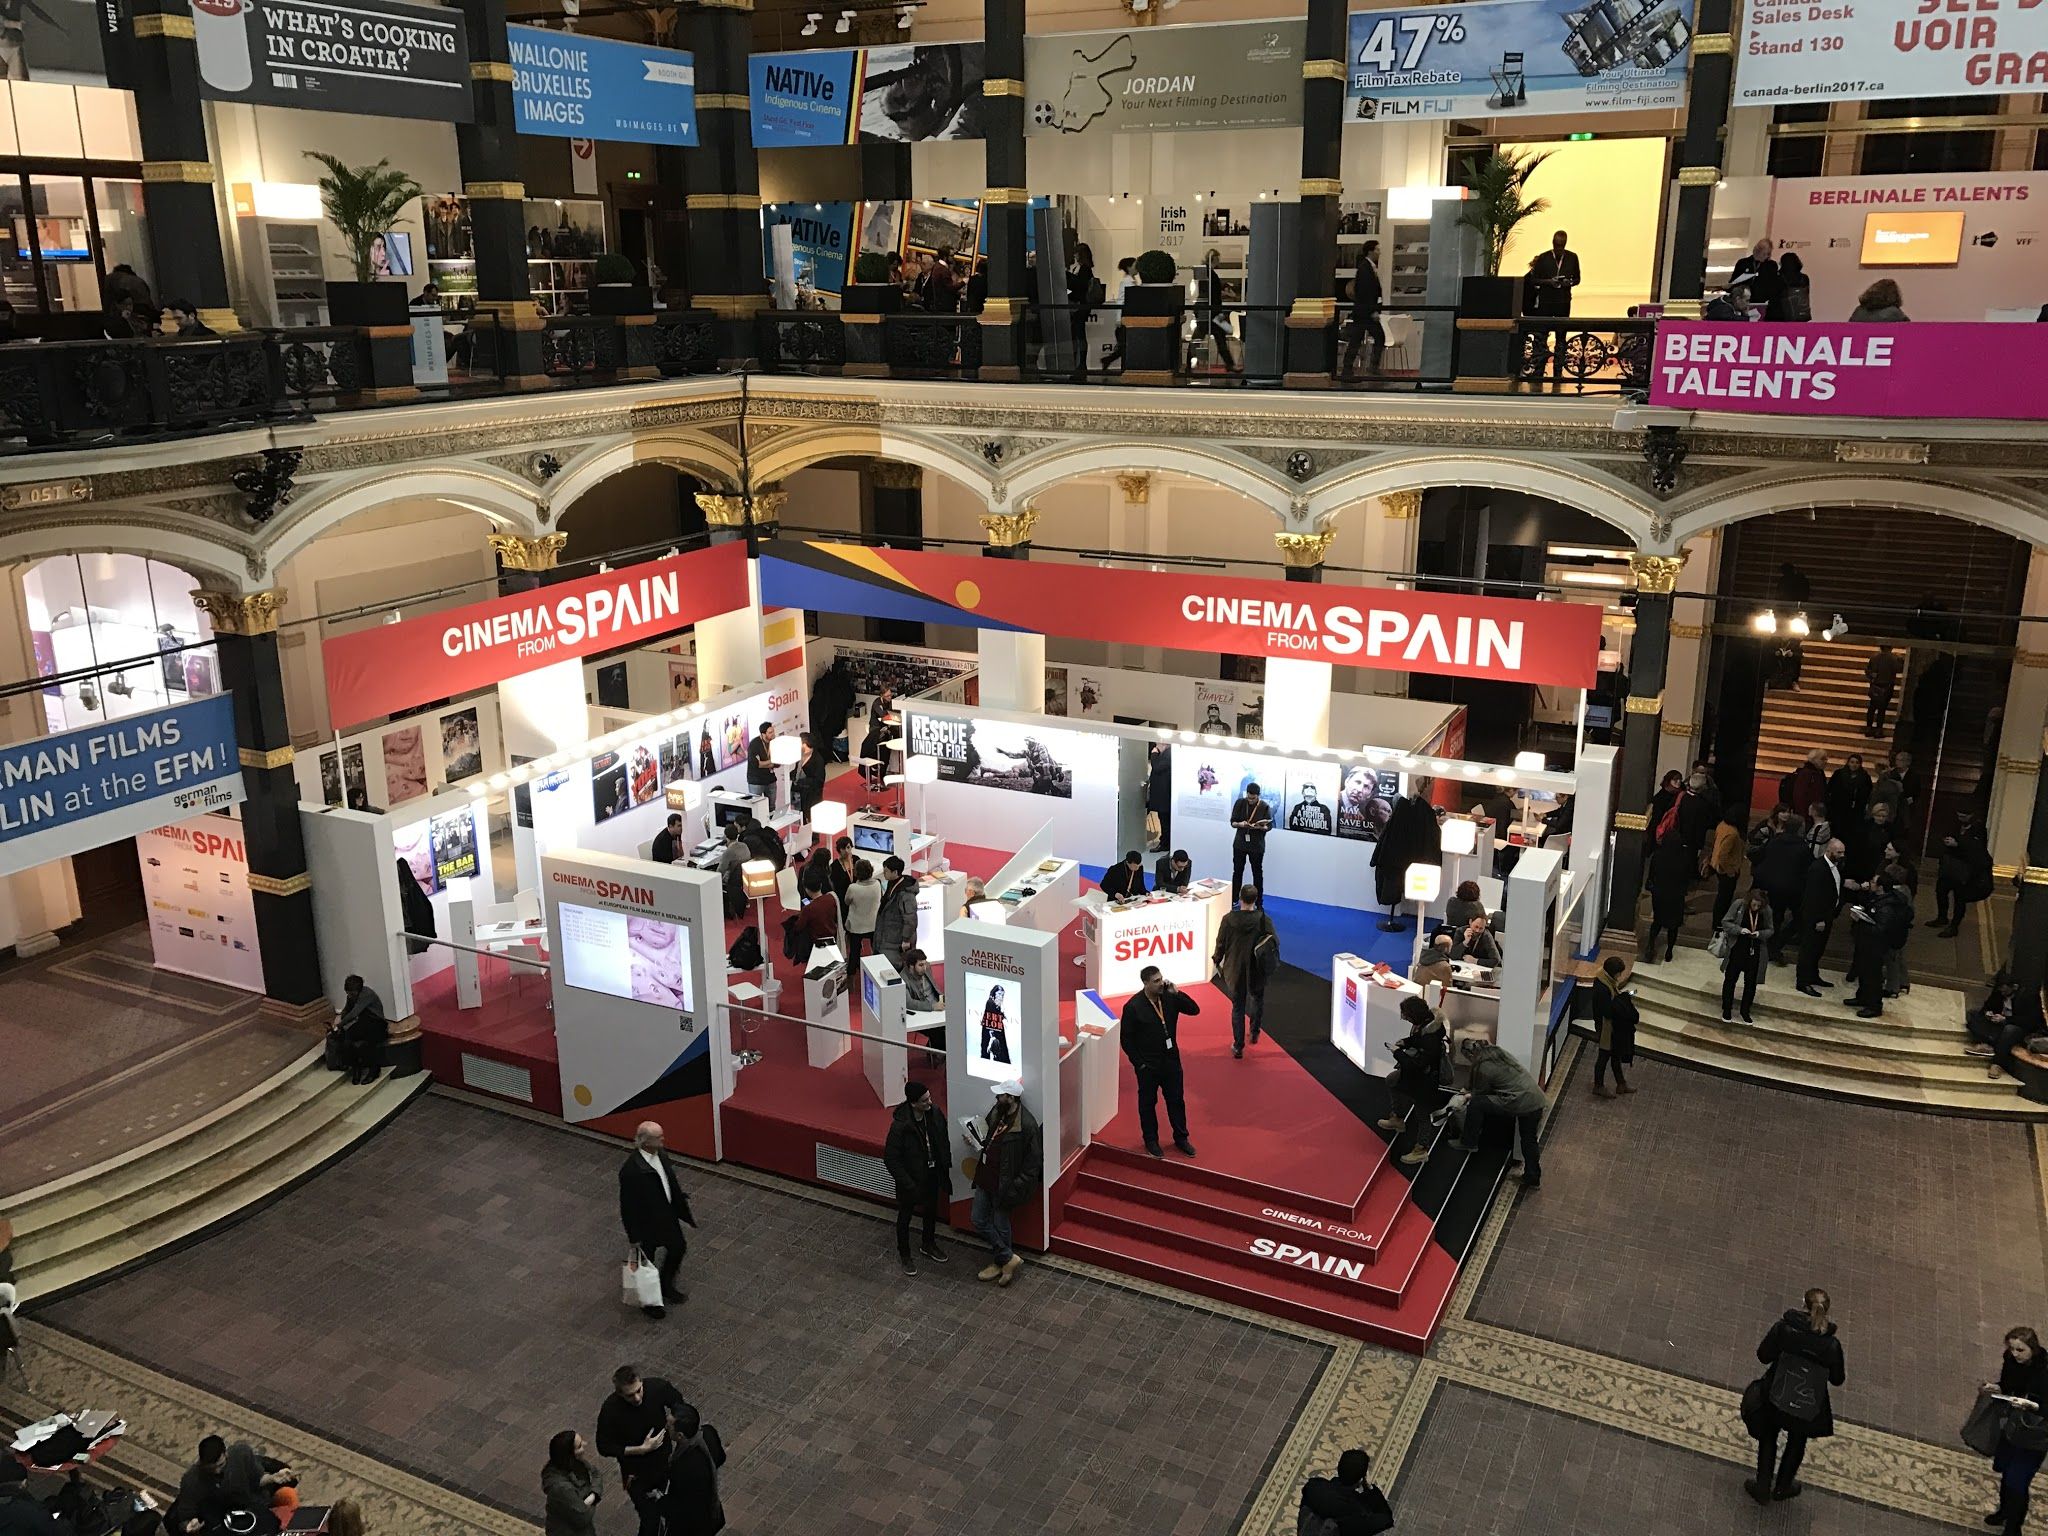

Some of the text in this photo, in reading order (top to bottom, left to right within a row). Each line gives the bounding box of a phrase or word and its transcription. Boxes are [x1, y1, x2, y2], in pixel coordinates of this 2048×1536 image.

[106, 2, 118, 33] VISIT
[1751, 5, 1855, 24] Sales Desk
[262, 6, 456, 53] WHAT'S COOKING
[266, 34, 411, 72] IN CROATIA?
[1359, 14, 1466, 71] 47%
[1748, 36, 1844, 55] Stand 130
[508, 41, 589, 73] WALLONIE
[511, 69, 592, 99] BRUXELLES
[765, 64, 834, 101] NATIVe
[1356, 71, 1461, 87] Film Tax Rebate
[1600, 68, 1665, 79] Your Ultimate
[1122, 76, 1196, 95] JORDAN
[1586, 79, 1677, 93] Filming Destination
[1743, 81, 1885, 98] canada-berlin2017.ca
[523, 98, 585, 125] IMAGES
[764, 93, 841, 117] Indigenous Cinema
[1121, 93, 1288, 110] Your Next Filming Destination
[1381, 99, 1453, 115] FILM FIJI
[1585, 95, 1675, 107] www.film-fiji.com
[1809, 186, 2029, 206] BERLINALE TALENTS
[1160, 205, 1187, 219] Irish
[1160, 219, 1186, 232] Film
[1159, 236, 1185, 247] 2017
[816, 246, 843, 261] Cinema
[1664, 333, 1895, 367] BERLINALE
[1662, 367, 1837, 401] TALENTS
[30, 485, 63, 503] OST
[442, 571, 680, 657] CINEMA SPAIN
[1181, 594, 1525, 670] CINEMA SPAIN
[1267, 631, 1318, 651] FROM
[517, 634, 556, 659] FROM
[768, 688, 799, 711] Spain
[912, 714, 967, 746] RESCUE
[0, 718, 182, 791] MAN FILMS
[912, 739, 967, 760] UNDER FIRE
[64, 782, 94, 812] at
[101, 771, 147, 801] the
[154, 746, 215, 786] EFM
[173, 784, 218, 808] german
[203, 790, 233, 807] films
[1340, 806, 1360, 815] MAY
[145, 825, 191, 842] INEMA
[1292, 816, 1329, 830] A SYMBOL
[1339, 818, 1374, 829] SAVE US
[438, 862, 456, 875] THE
[456, 853, 475, 868] BAR
[552, 872, 655, 907] CINEMA SPAIN
[604, 900, 629, 910] EUROPEAN
[629, 905, 641, 913] FILM
[641, 908, 661, 916] MARKET
[1114, 924, 1159, 939] CINEMA
[971, 948, 1014, 964] MARKET
[1115, 930, 1194, 961] SPAIN
[960, 955, 1025, 976] SCREENINGS
[1261, 1207, 1373, 1242] CINEMA FROM
[1249, 1238, 1365, 1280] SPAIN
